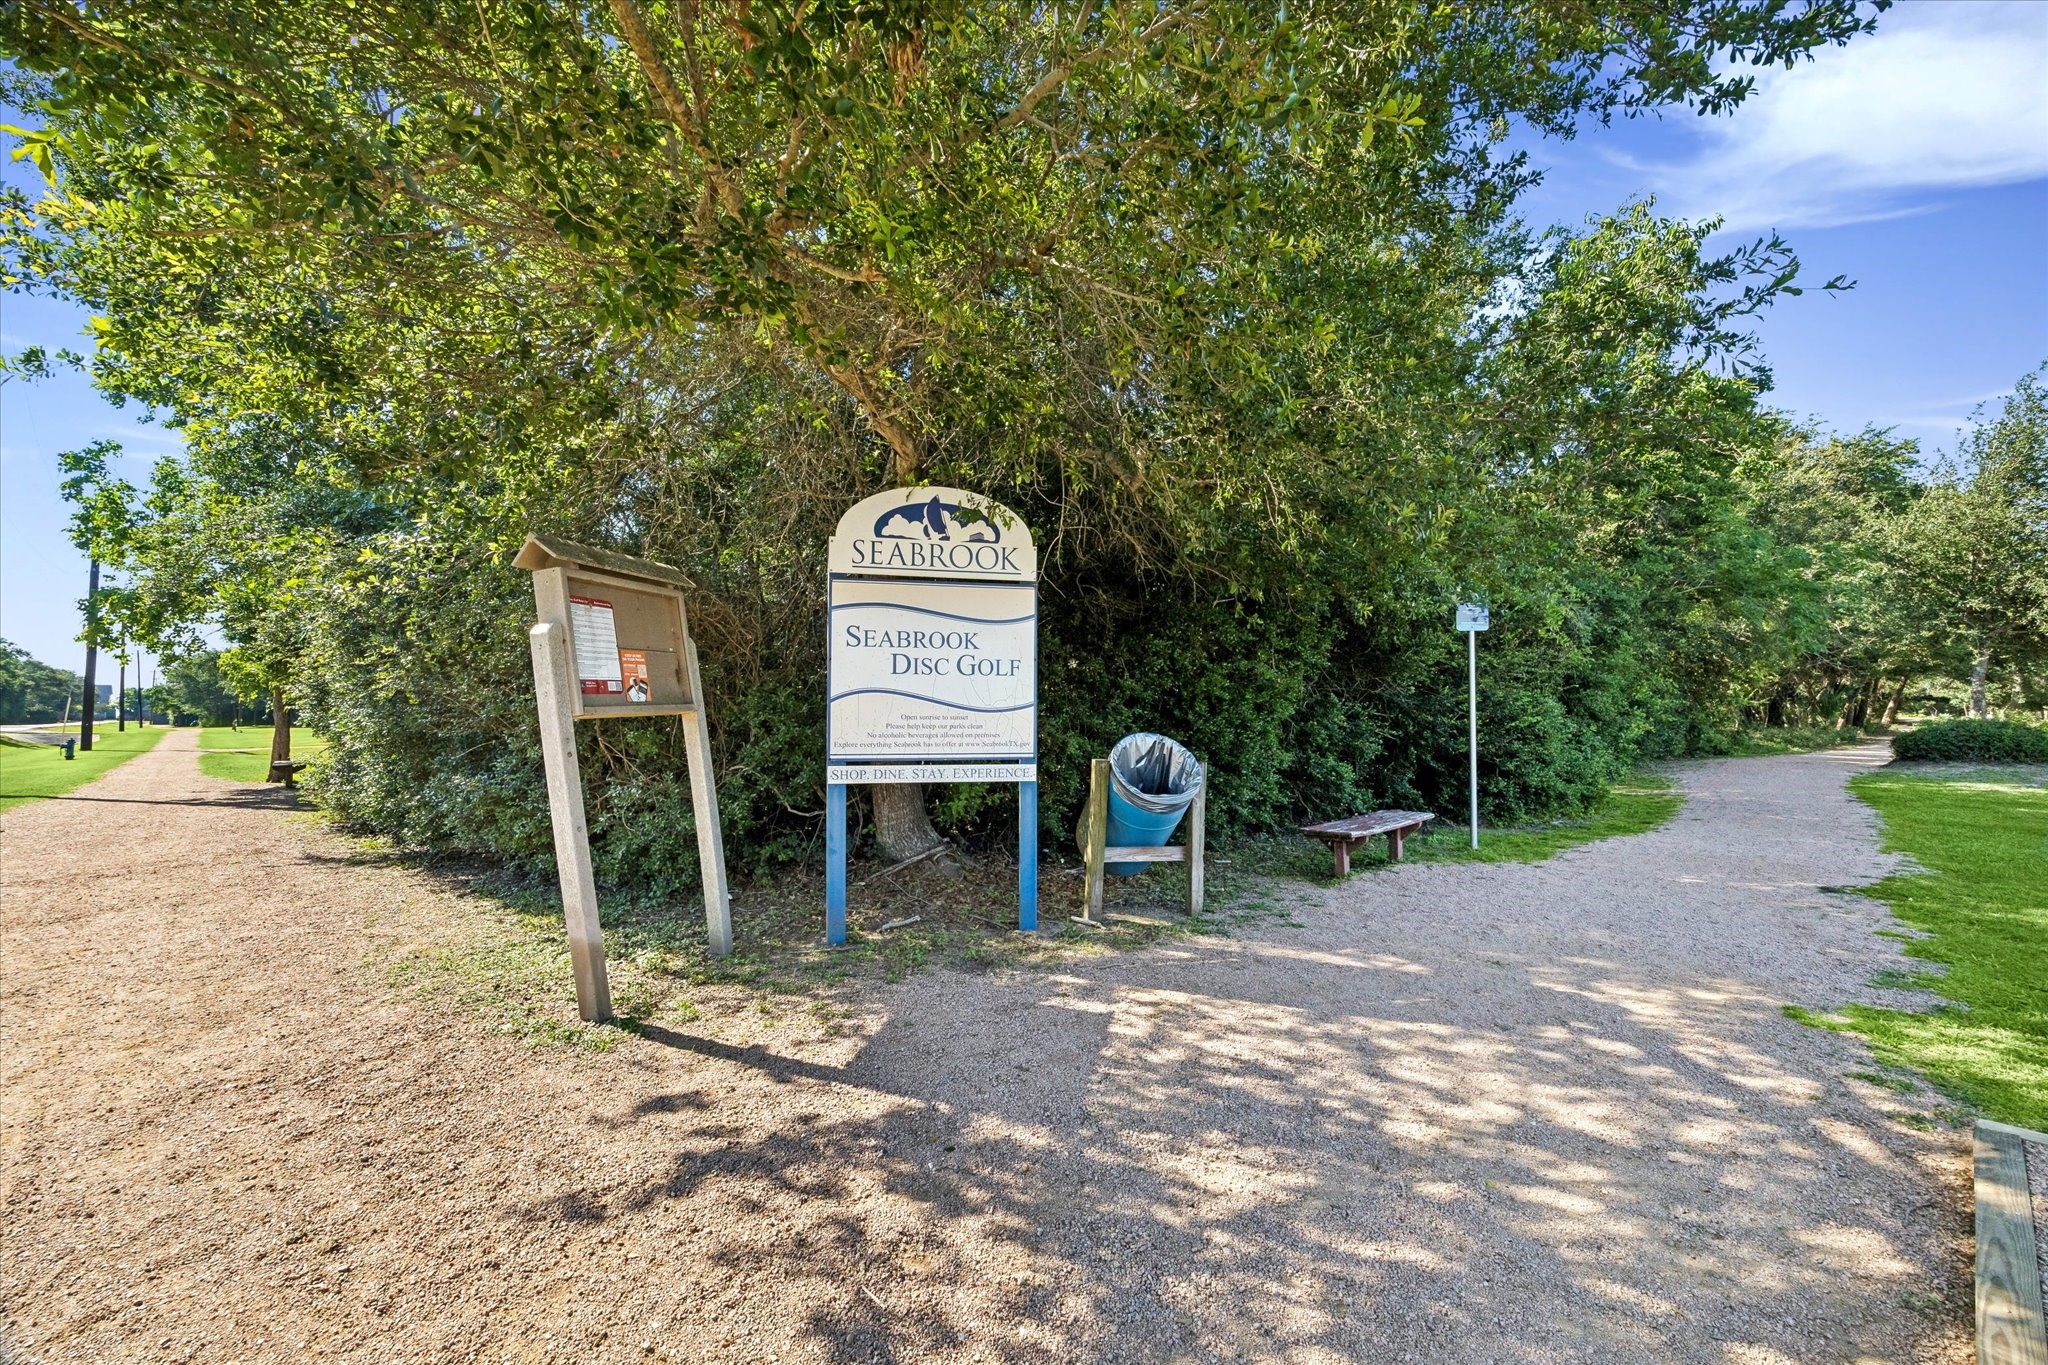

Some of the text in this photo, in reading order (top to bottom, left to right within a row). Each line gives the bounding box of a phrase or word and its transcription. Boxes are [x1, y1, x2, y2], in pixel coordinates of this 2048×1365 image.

[852, 539, 1021, 571] SEABROOK
[846, 625, 979, 649] SEABROOK
[891, 653, 1021, 677] DISC GOLF
[831, 767, 1033, 780] SHOP. DINE. STAY. EXPERIENCE.
